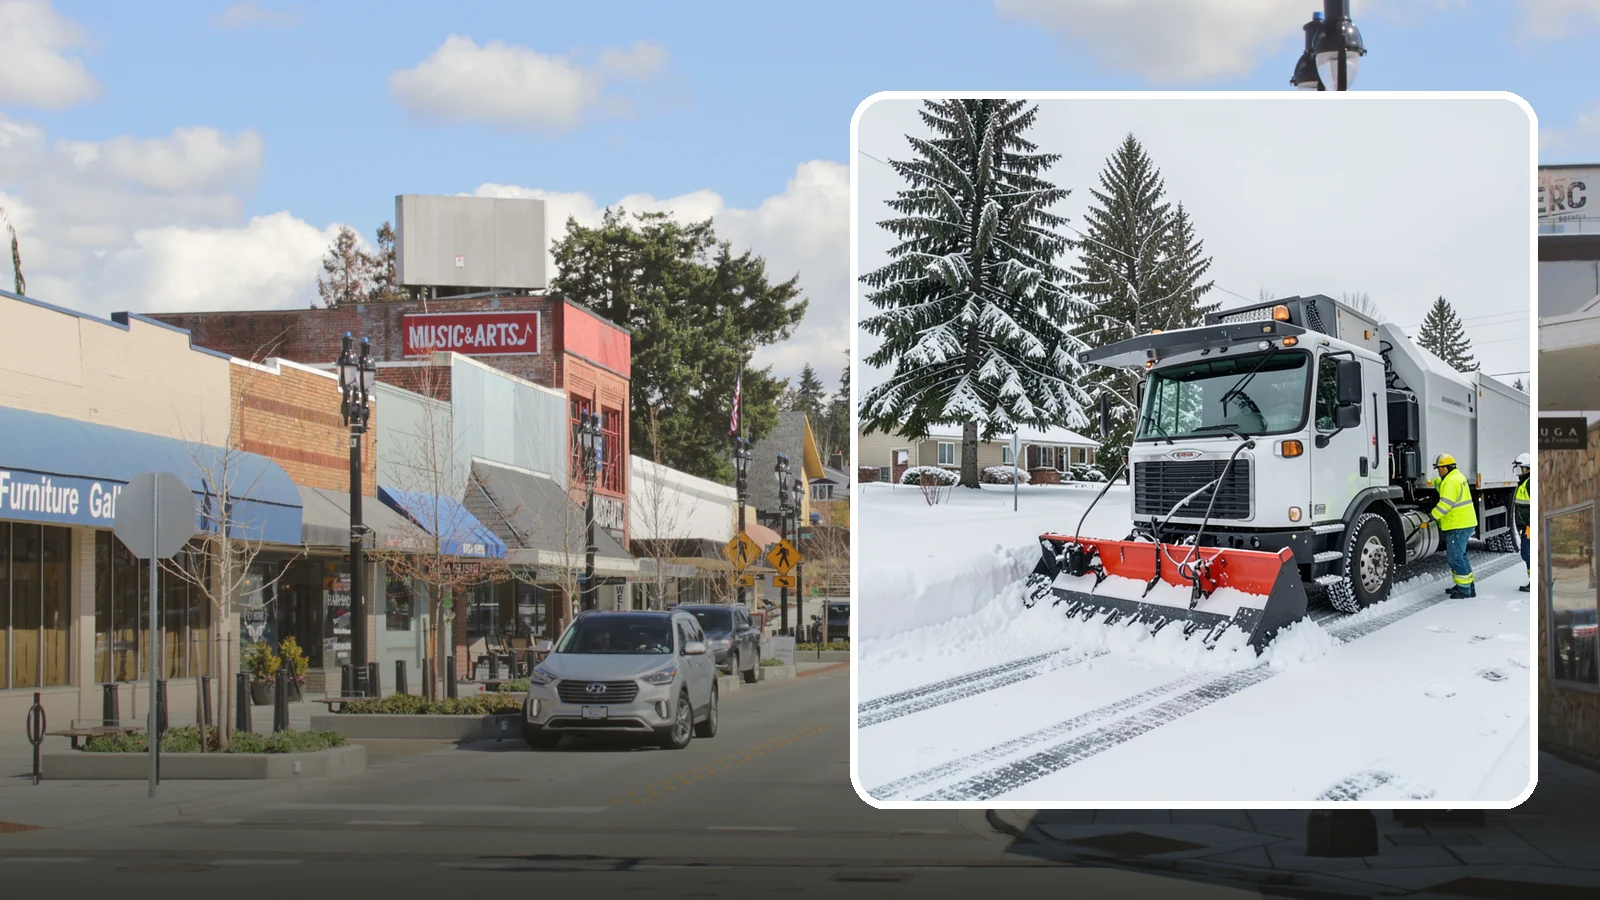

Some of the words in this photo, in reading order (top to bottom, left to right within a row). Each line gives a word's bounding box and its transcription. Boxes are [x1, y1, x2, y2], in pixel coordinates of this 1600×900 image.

[409, 322, 520, 349] MUSIC&ARTS
[1540, 427, 1577, 437] UGA
[0, 471, 79, 515] Furniture
[89, 482, 122, 519] Gal
